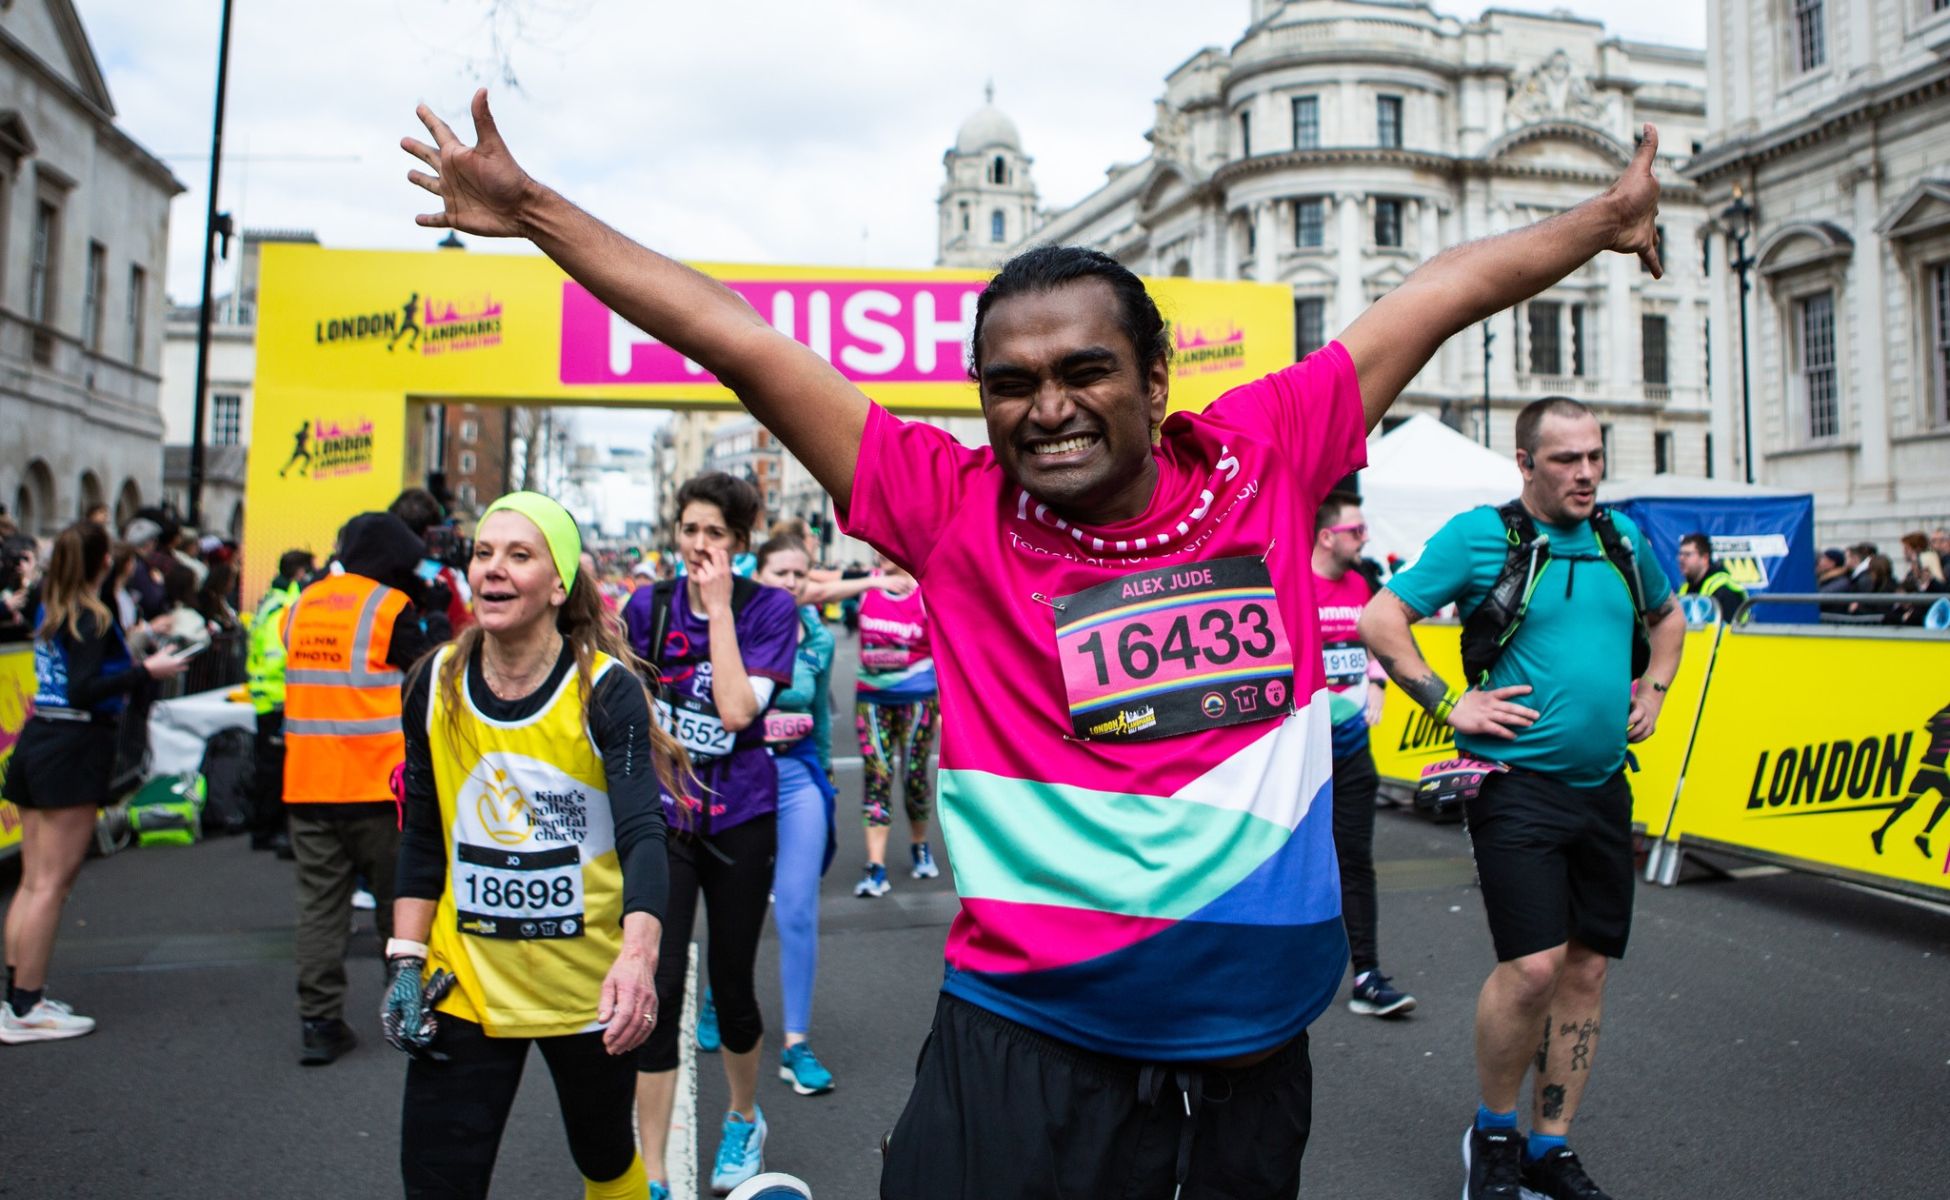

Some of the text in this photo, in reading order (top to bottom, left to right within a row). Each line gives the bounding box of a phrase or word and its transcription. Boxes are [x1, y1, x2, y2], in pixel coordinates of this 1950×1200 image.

[316, 312, 396, 345] LONDON
[424, 319, 500, 342] LANDMARKS
[314, 434, 372, 457] LONDON
[1121, 568, 1213, 599] ALEX JUDE
[1077, 603, 1276, 687] 16433
[295, 651, 342, 663] PHOTO
[1273, 692, 1281, 702] 6
[1090, 719, 1119, 735] LONDON
[1128, 713, 1156, 729] LANDMARKS
[1747, 731, 1914, 810] LONDON
[535, 790, 586, 806] King's
[533, 802, 586, 817] college
[526, 813, 586, 833] hospital
[535, 828, 587, 843] charity
[506, 856, 521, 866] JO
[465, 873, 575, 910] 18698
